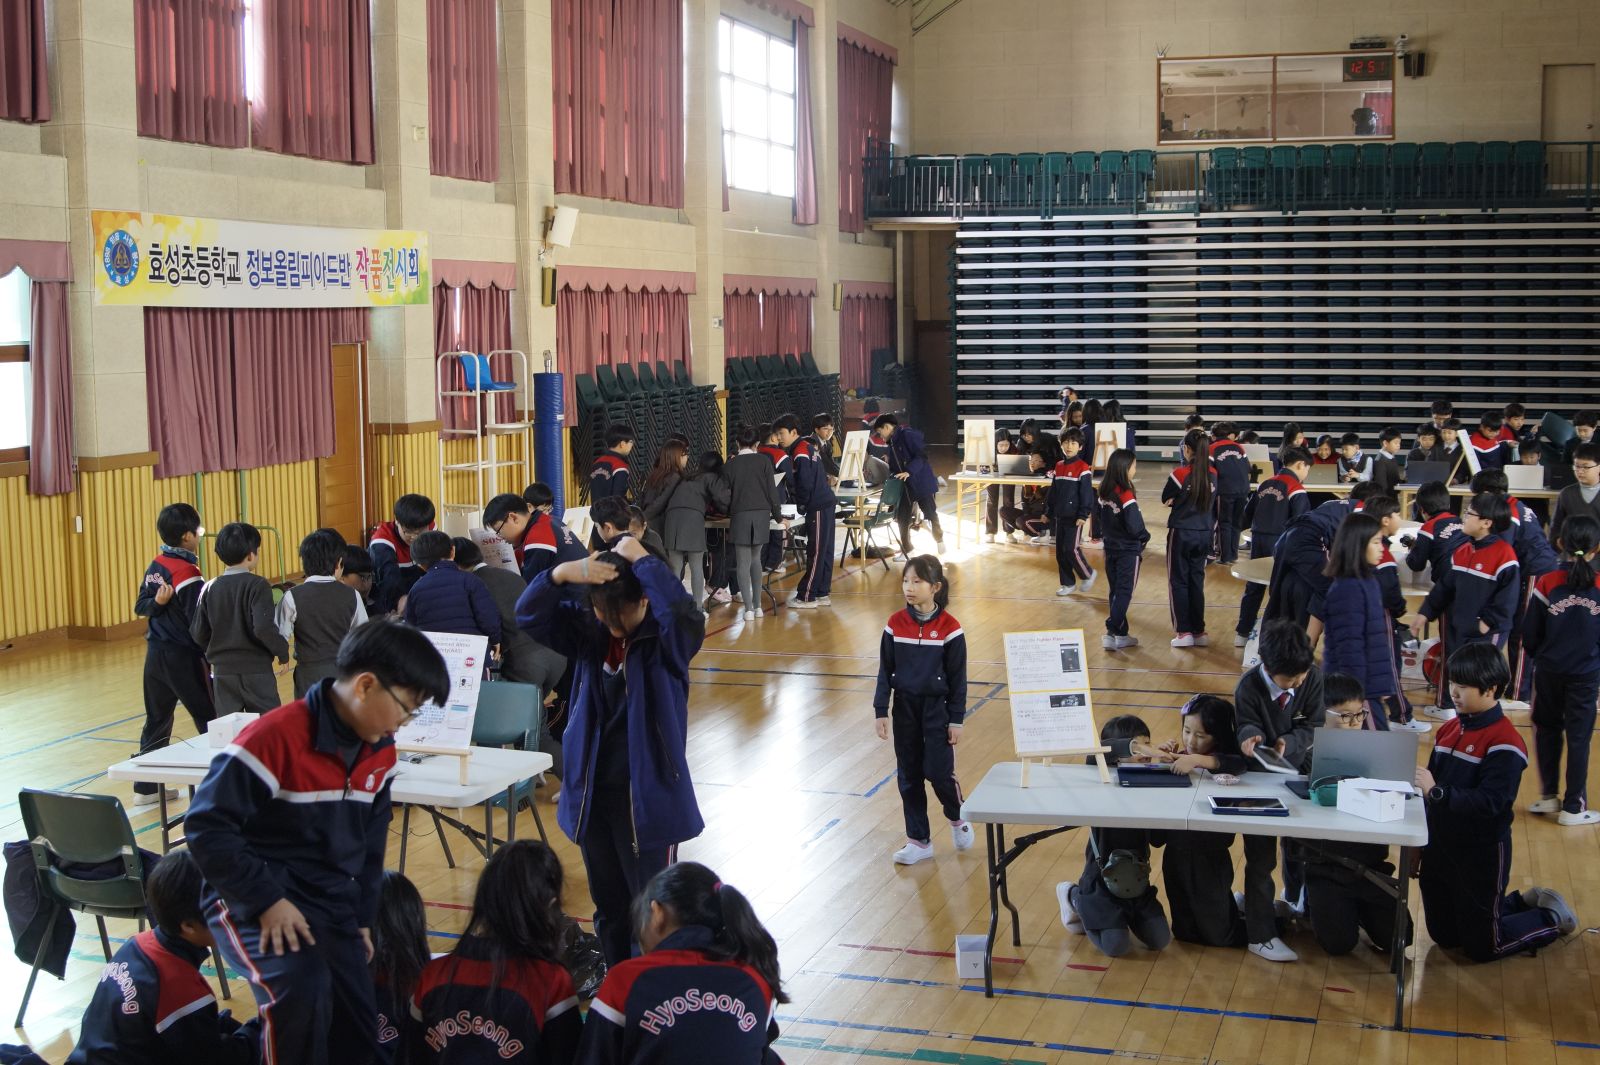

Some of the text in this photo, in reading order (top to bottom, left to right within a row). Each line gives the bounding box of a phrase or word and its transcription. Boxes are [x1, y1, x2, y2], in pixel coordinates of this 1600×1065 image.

[148, 243, 420, 290] 효성초등학교 정보올림피아드반 작품전시회
[424, 1009, 525, 1060] HyoSeong
[638, 988, 757, 1036] HyoSeong
